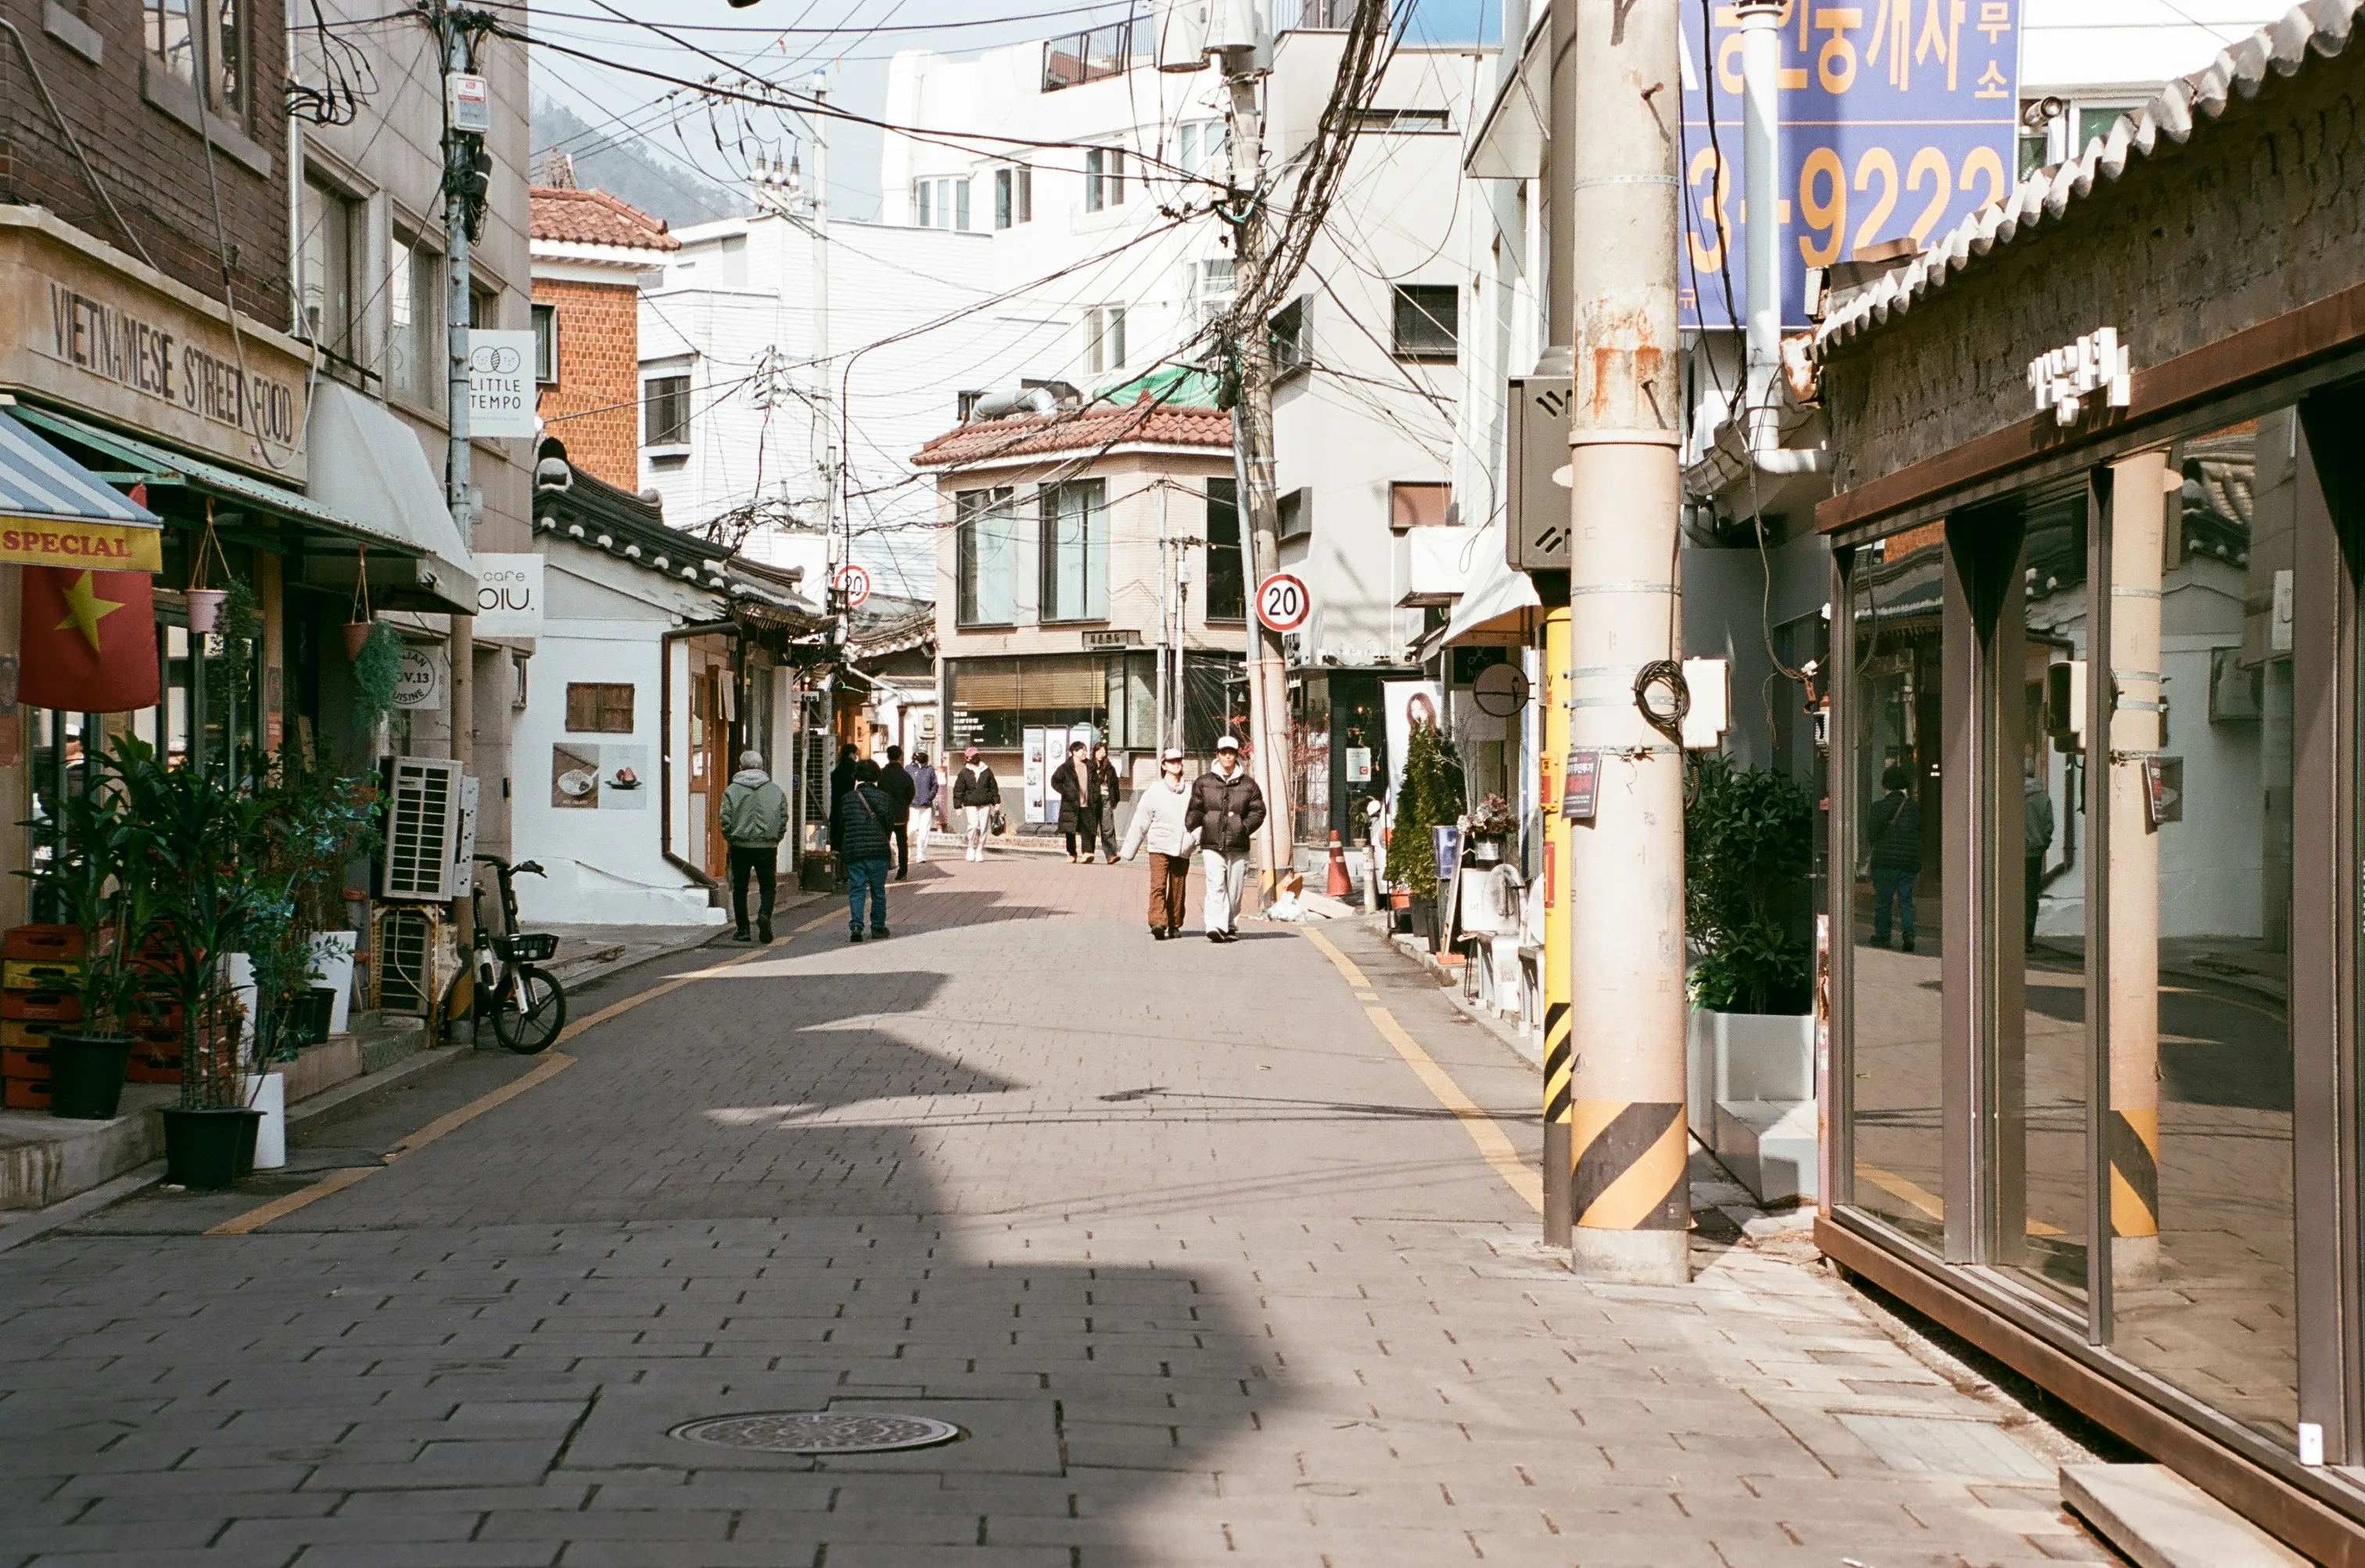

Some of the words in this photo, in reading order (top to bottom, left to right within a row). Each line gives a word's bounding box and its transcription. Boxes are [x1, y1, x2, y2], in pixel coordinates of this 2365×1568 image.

[51, 282, 174, 400] VIETNAMESE
[184, 344, 243, 427] STREET
[253, 375, 292, 444] FOOD
[470, 378, 521, 393] LITTLE
[471, 395, 521, 409] TEMPO
[2, 530, 133, 558] SPECIAL
[483, 571, 525, 582] cafe
[1269, 587, 1297, 616] 20
[393, 688, 424, 702] UISINE
